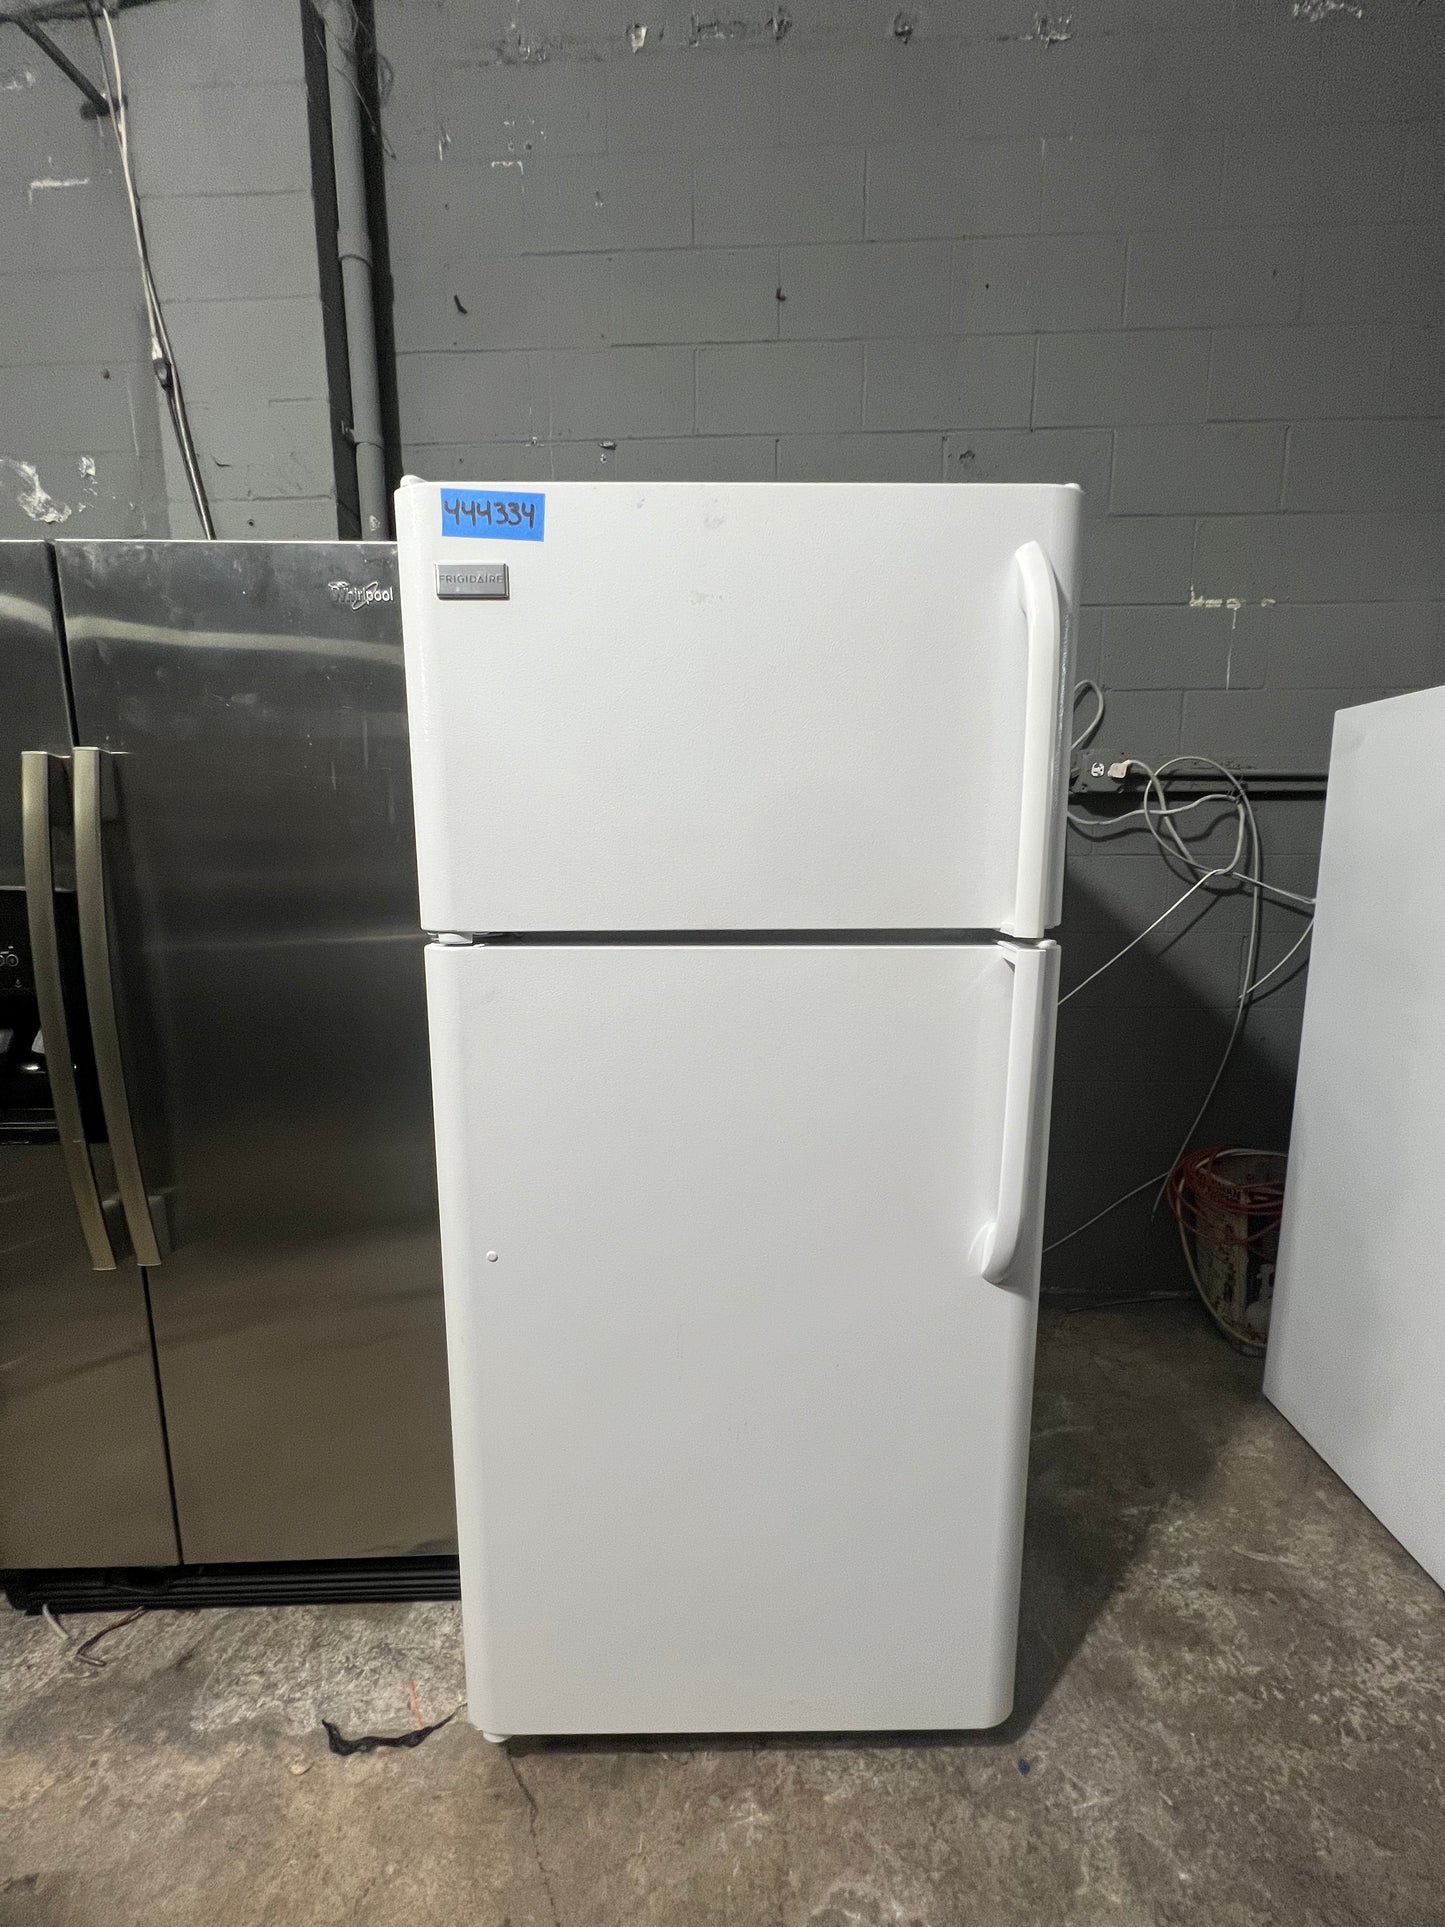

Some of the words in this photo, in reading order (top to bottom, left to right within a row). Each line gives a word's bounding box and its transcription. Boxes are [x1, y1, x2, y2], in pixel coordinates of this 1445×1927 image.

[444, 498, 535, 528] 444334
[439, 574, 504, 584] FRIGIDAIRE
[328, 581, 394, 610] Whirlpool
